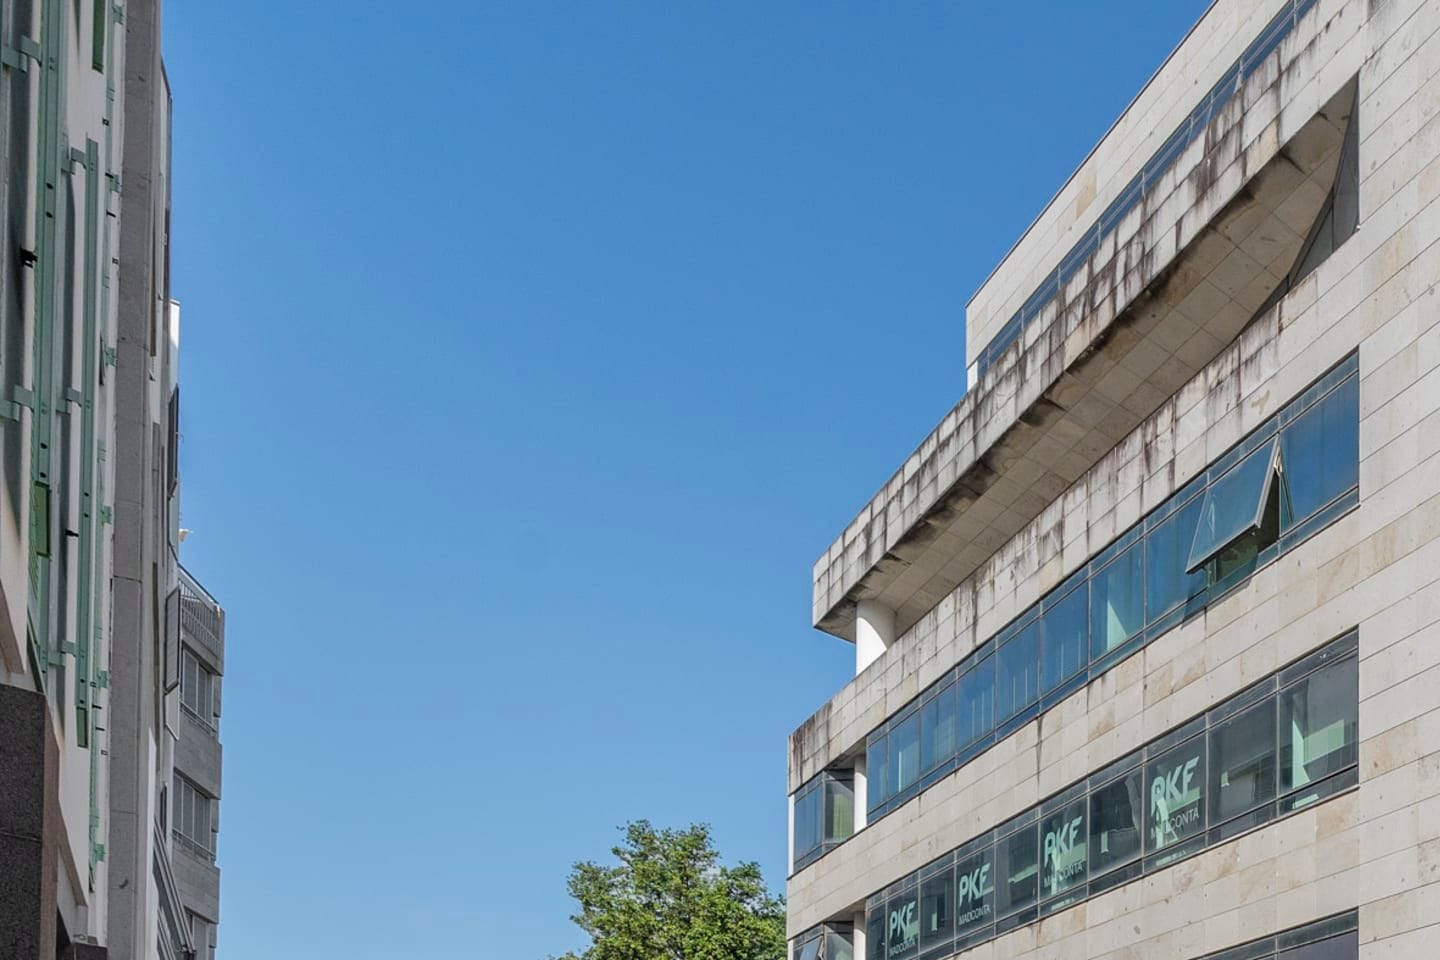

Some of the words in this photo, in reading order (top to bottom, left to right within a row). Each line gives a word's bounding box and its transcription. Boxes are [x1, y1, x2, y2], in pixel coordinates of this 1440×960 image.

[1150, 755, 1200, 817] PKF
[1044, 816, 1083, 867] PKF
[1150, 807, 1200, 840] MDCONTA
[959, 863, 991, 906] PKF
[889, 900, 916, 939] PKF
[959, 904, 991, 926] MADCONTA
